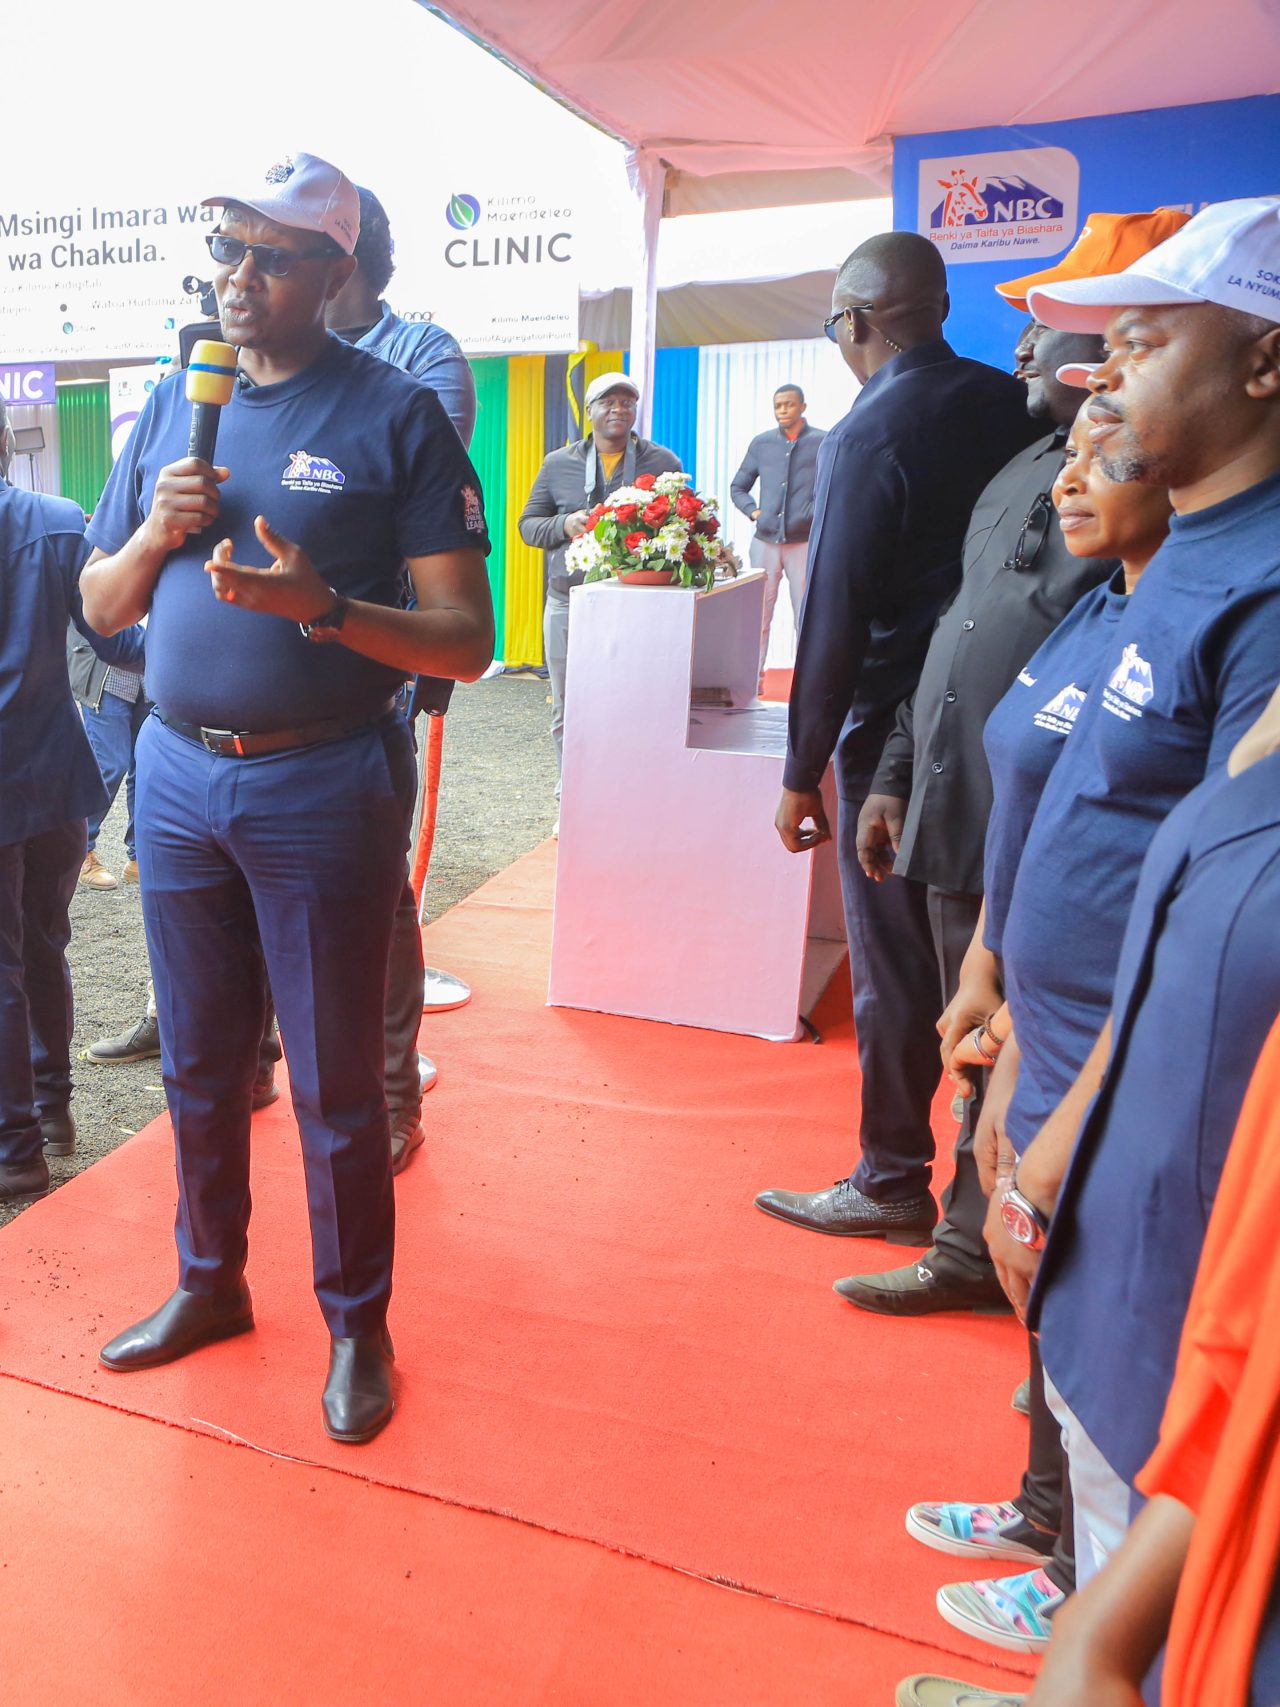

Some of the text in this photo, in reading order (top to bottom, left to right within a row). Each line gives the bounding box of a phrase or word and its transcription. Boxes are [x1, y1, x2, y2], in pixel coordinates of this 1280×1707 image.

[487, 195, 536, 207] Kilimo
[993, 196, 1054, 223] NBC
[92, 206, 168, 230] Imara
[177, 205, 215, 224] wa
[487, 207, 572, 223] Maendeleo
[929, 223, 1063, 242] Benki ya Taifa ya Biashara
[950, 236, 1040, 251] Daima Karibu Nawe.
[7, 252, 42, 271] wa
[51, 237, 166, 268] Chakula.
[444, 232, 573, 268] CLINIC
[1227, 275, 1280, 300] LA NYUM
[311, 467, 342, 482] NBC
